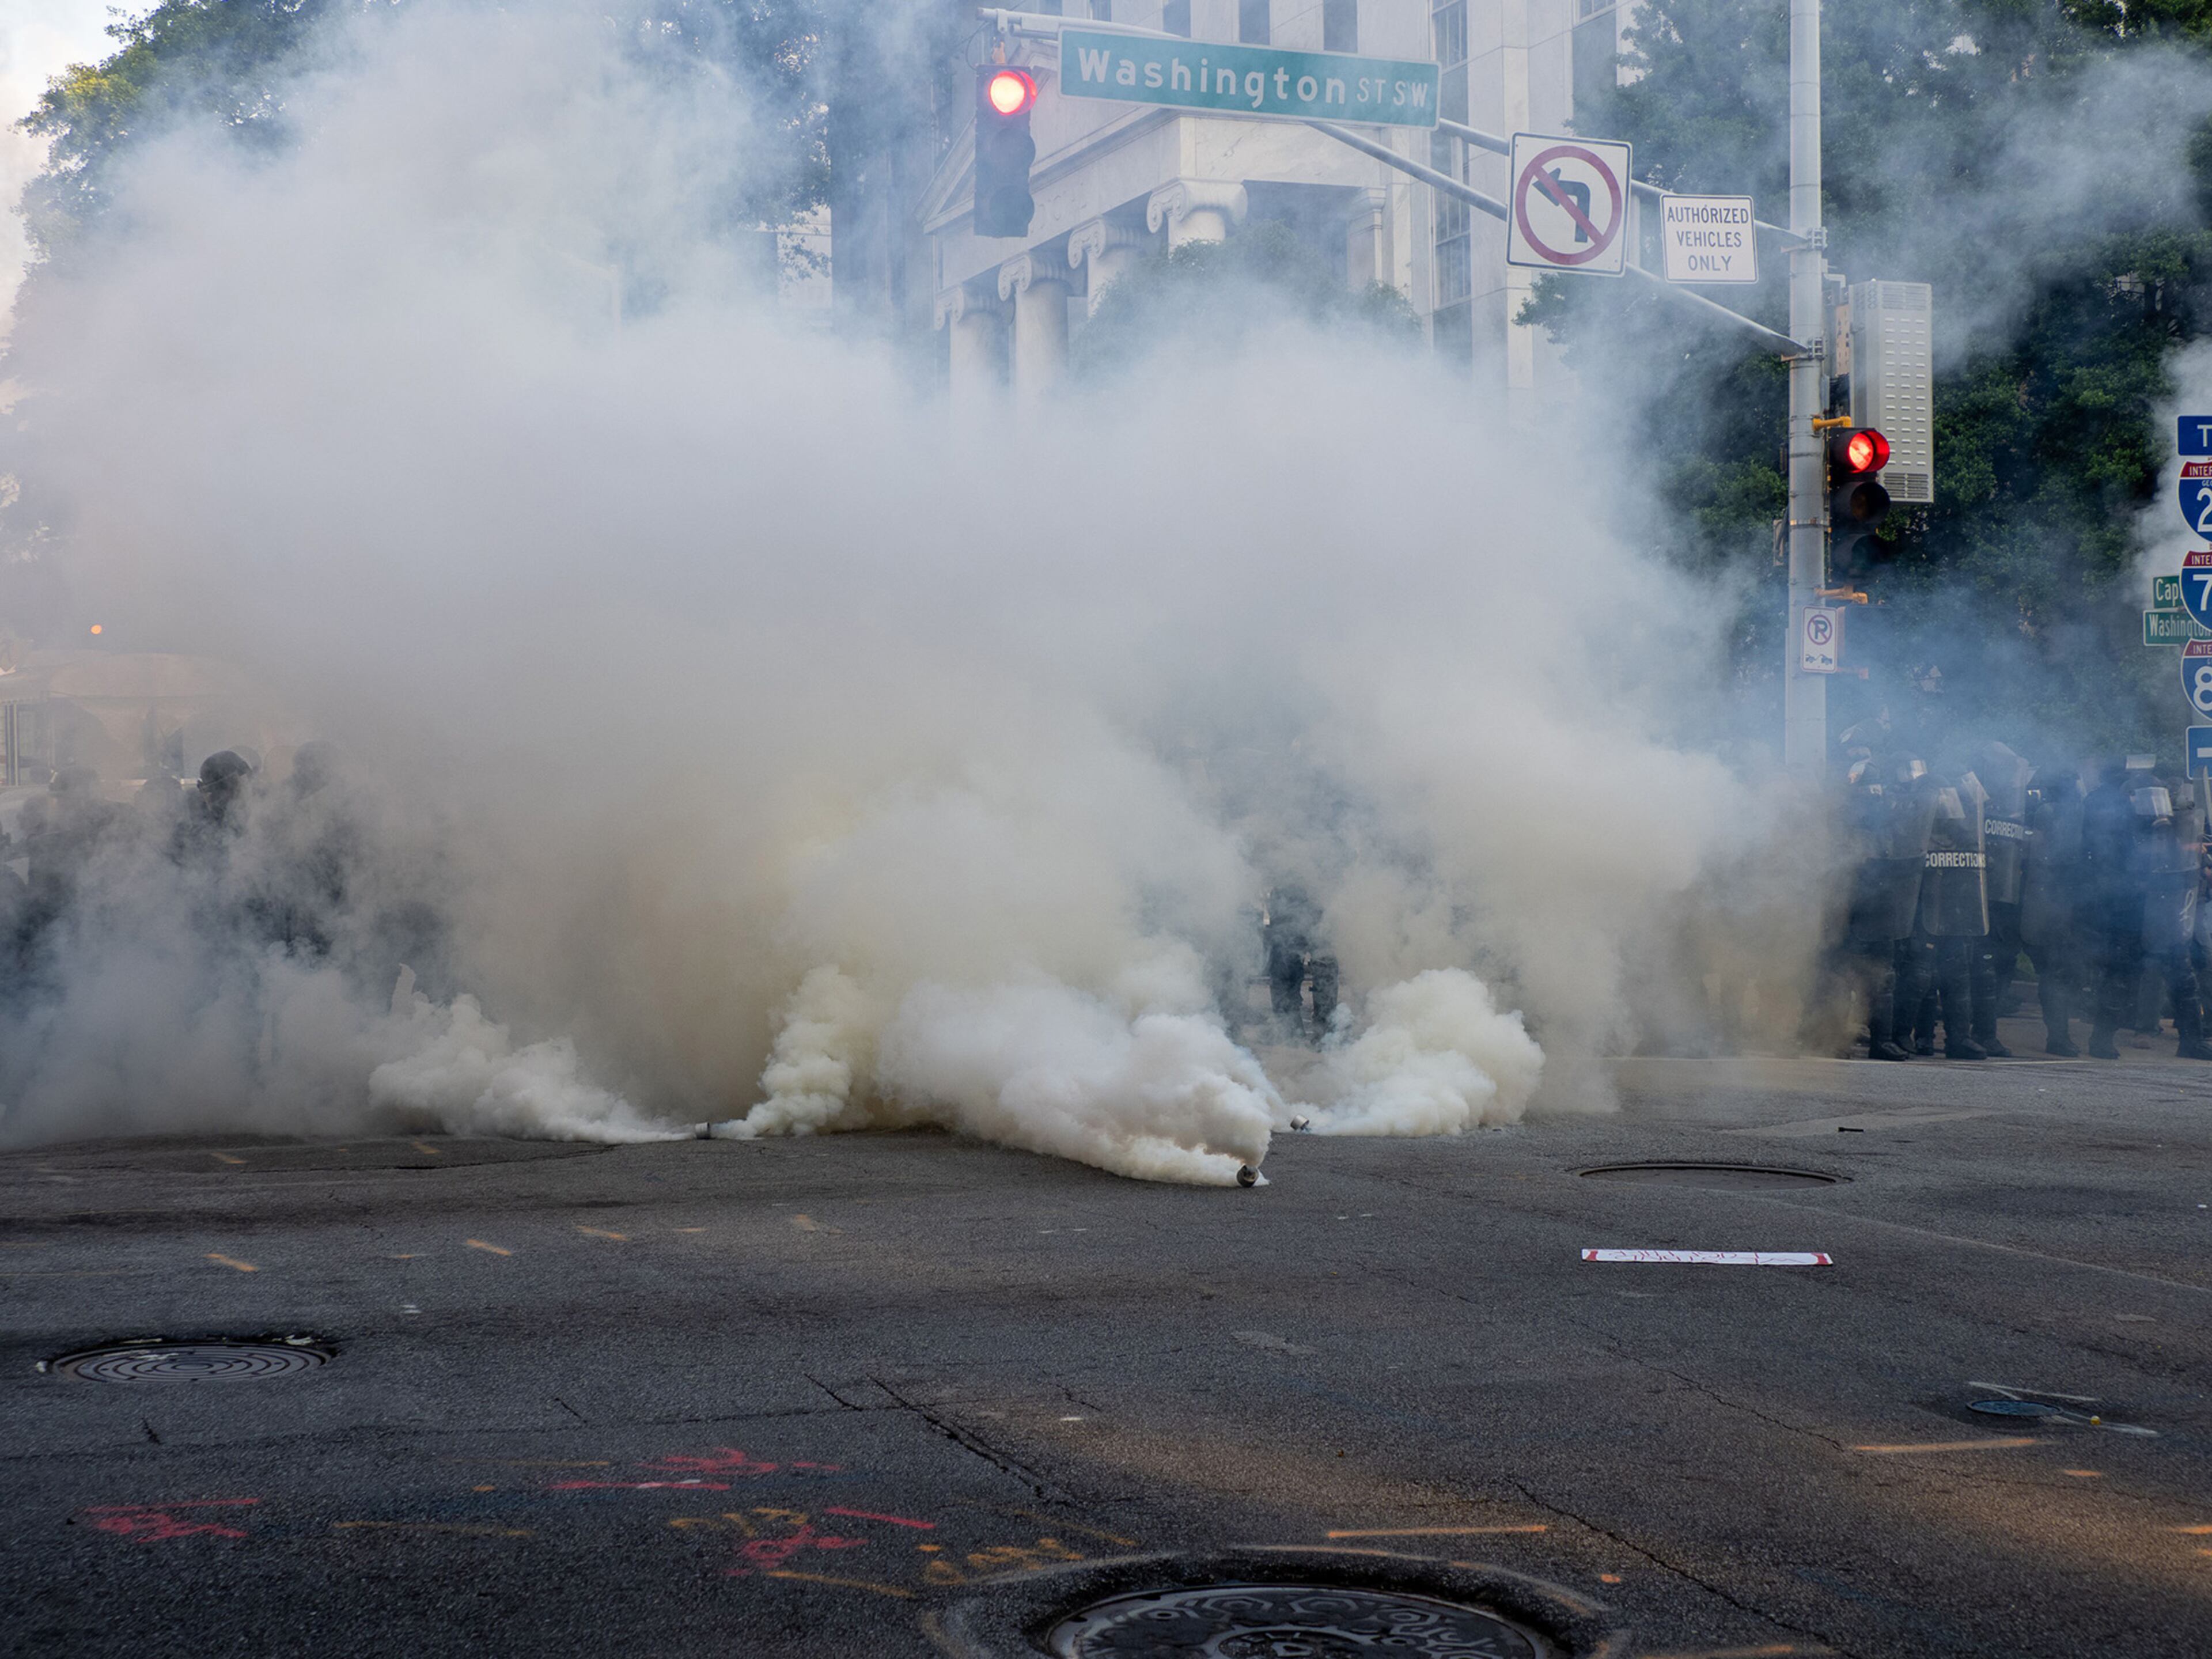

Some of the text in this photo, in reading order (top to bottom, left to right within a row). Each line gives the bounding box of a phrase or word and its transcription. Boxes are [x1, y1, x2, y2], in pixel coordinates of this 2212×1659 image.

[1078, 46, 1427, 108] Washington ST SW
[1667, 206, 1749, 224] AUTHORIZED
[1676, 230, 1742, 248] VEHICLES
[1688, 255, 1732, 271] ONLY
[2156, 578, 2181, 607] Cap
